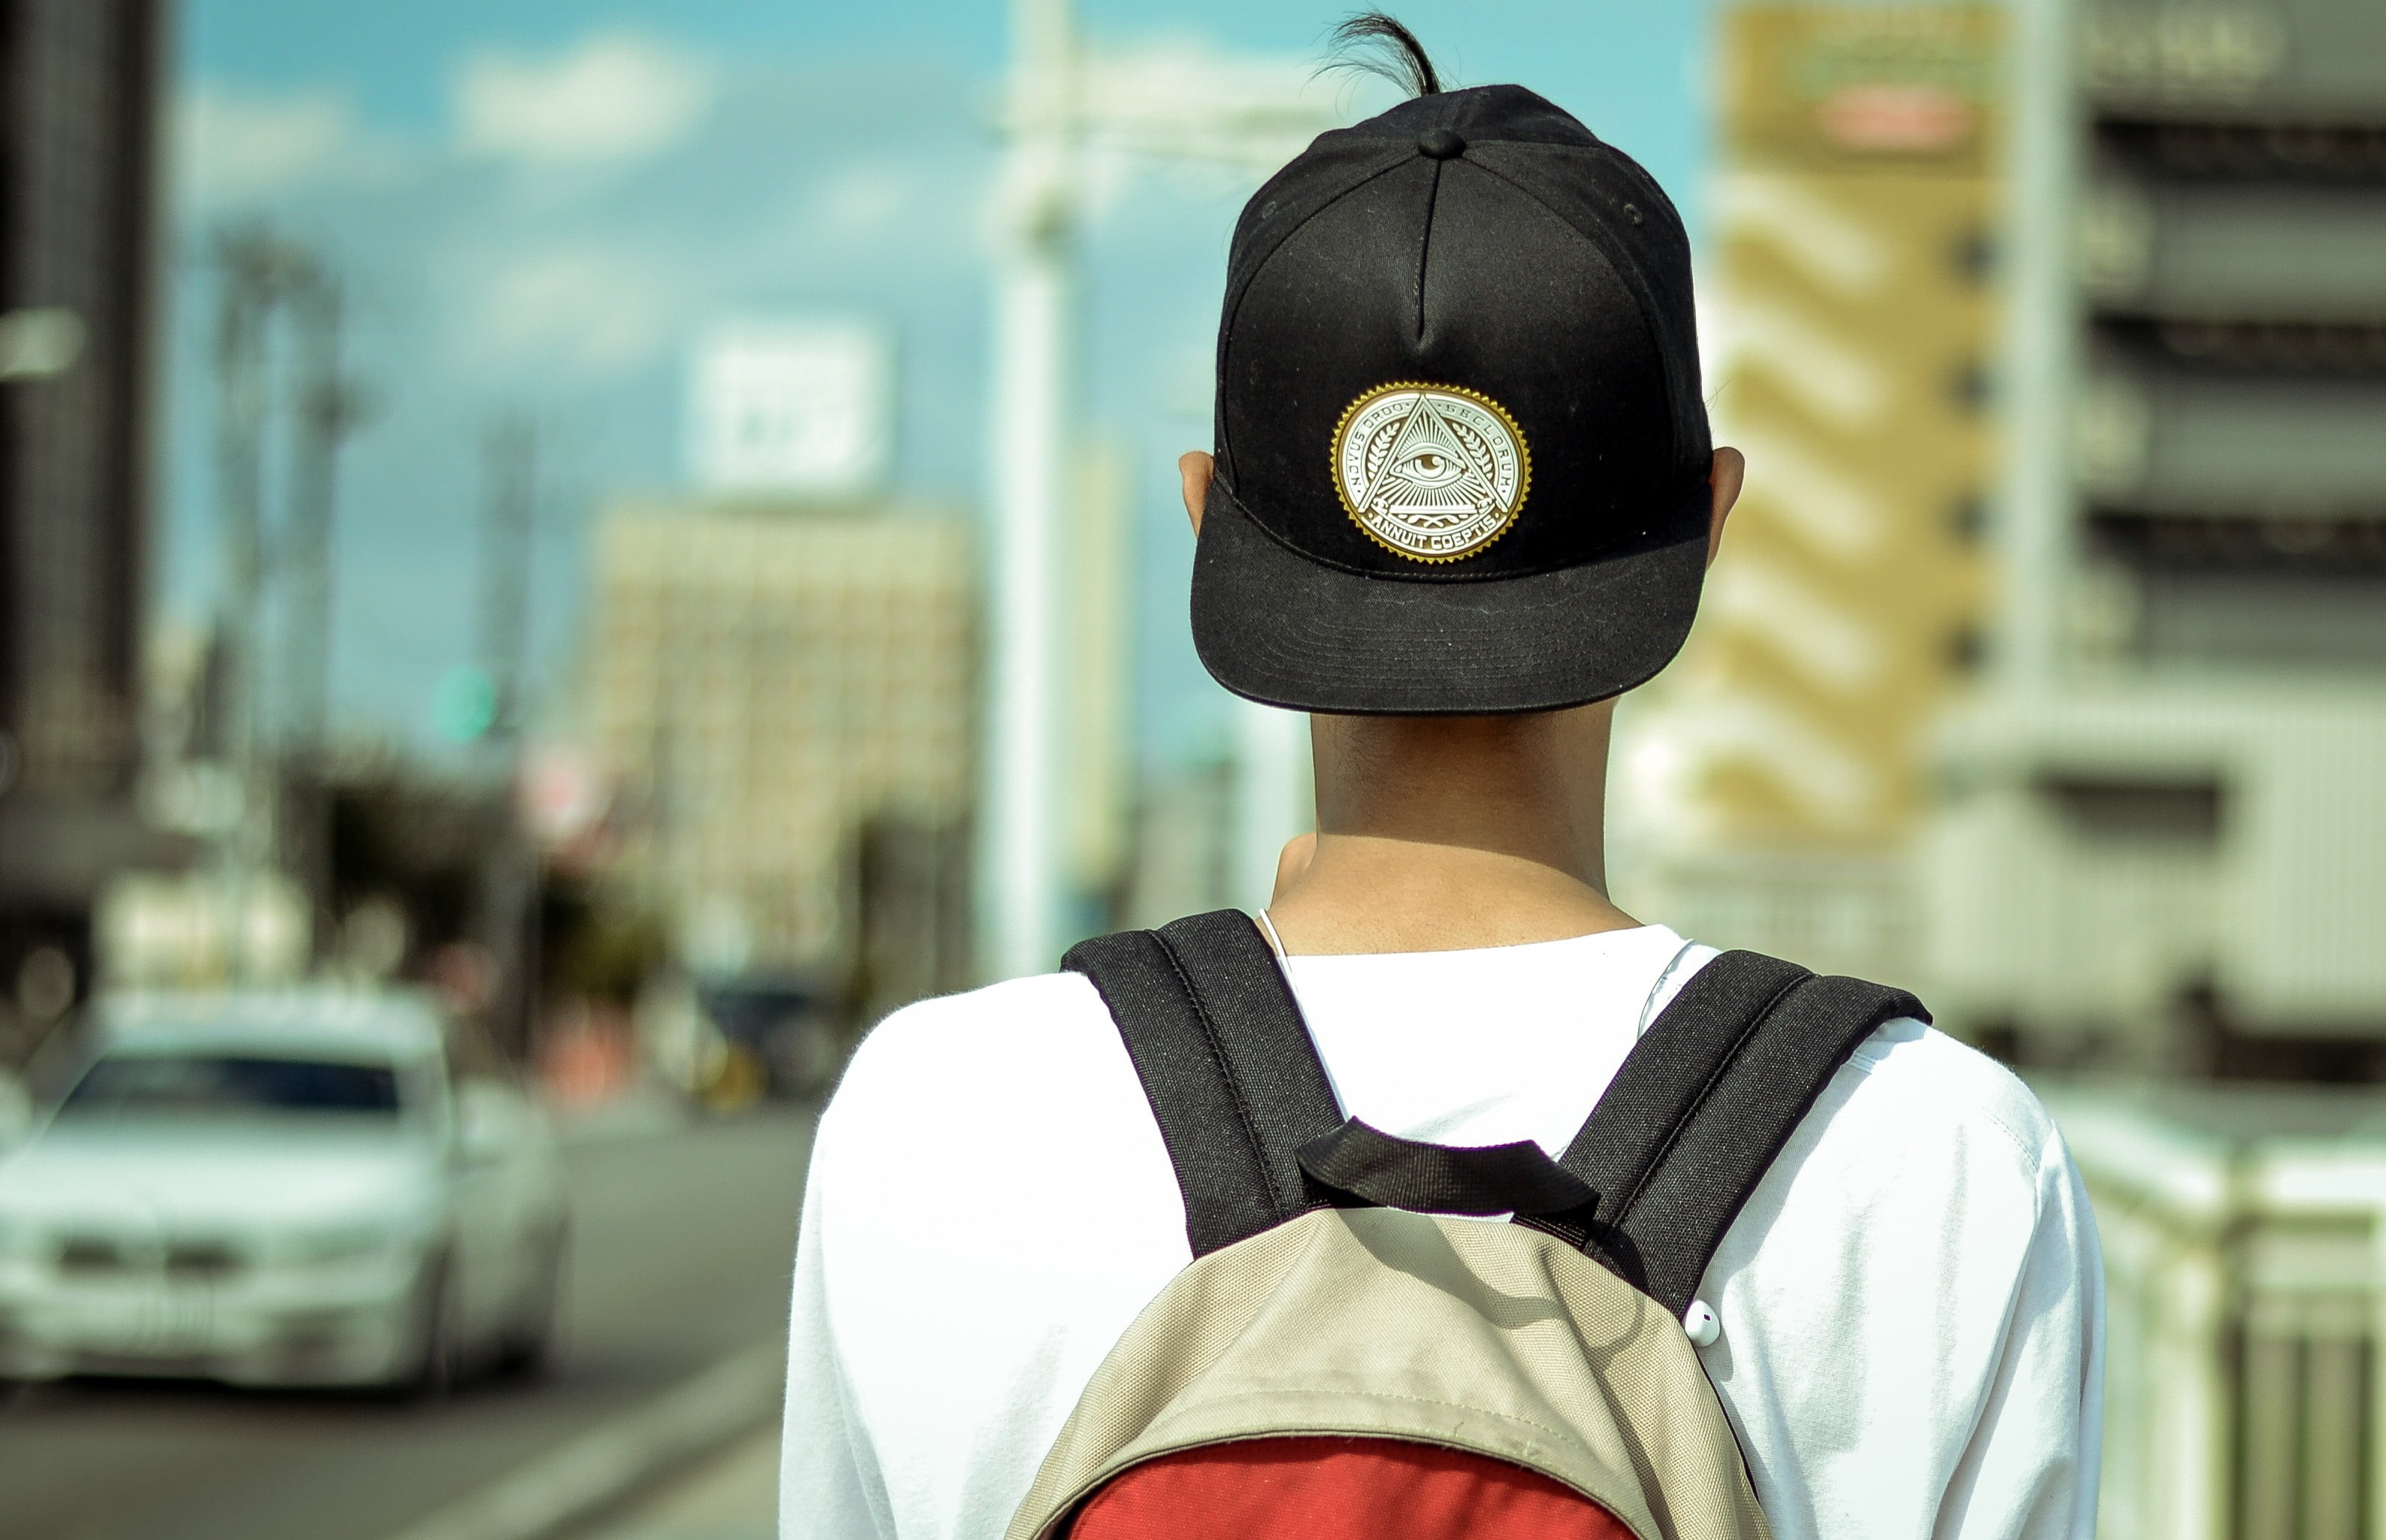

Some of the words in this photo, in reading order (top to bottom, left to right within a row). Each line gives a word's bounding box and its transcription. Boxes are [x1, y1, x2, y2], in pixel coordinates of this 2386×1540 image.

[1348, 431, 1365, 485] NOVUS
[1363, 403, 1403, 429] ORDO
[1445, 404, 1512, 486] SECLORUM
[1371, 515, 1428, 548] ANNUIT
[1431, 514, 1497, 550] COEPTIS
